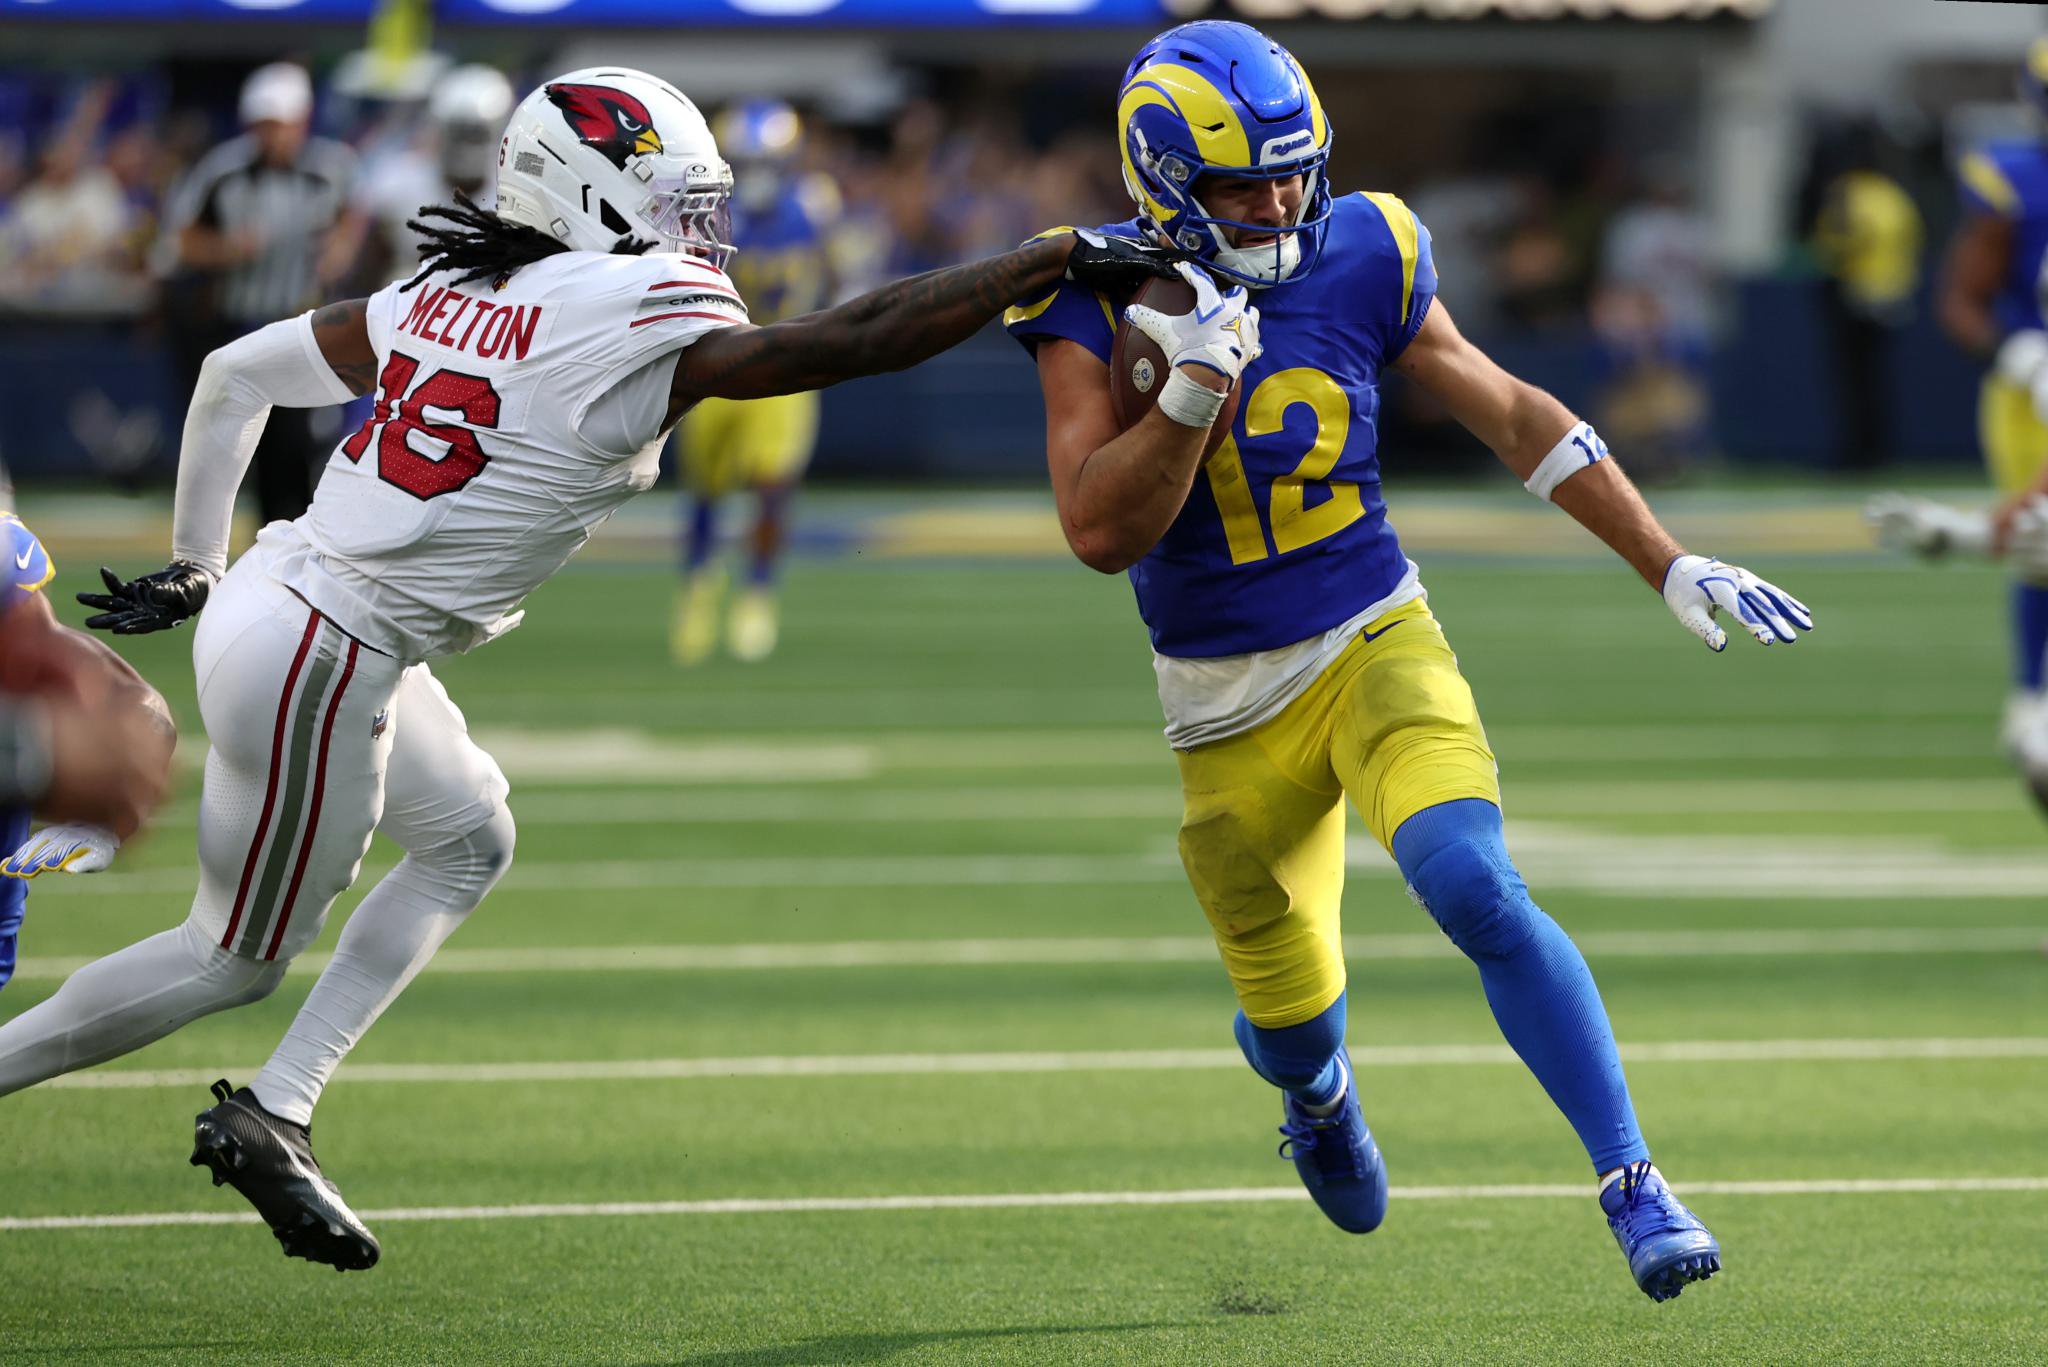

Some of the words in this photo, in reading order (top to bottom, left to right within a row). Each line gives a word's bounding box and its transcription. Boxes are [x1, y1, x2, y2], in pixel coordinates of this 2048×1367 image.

[1270, 135, 1312, 156] RAMS
[396, 282, 543, 361] MELTON
[341, 349, 502, 502] 16
[1571, 427, 1608, 465] 12
[1205, 366, 1367, 566] 12
